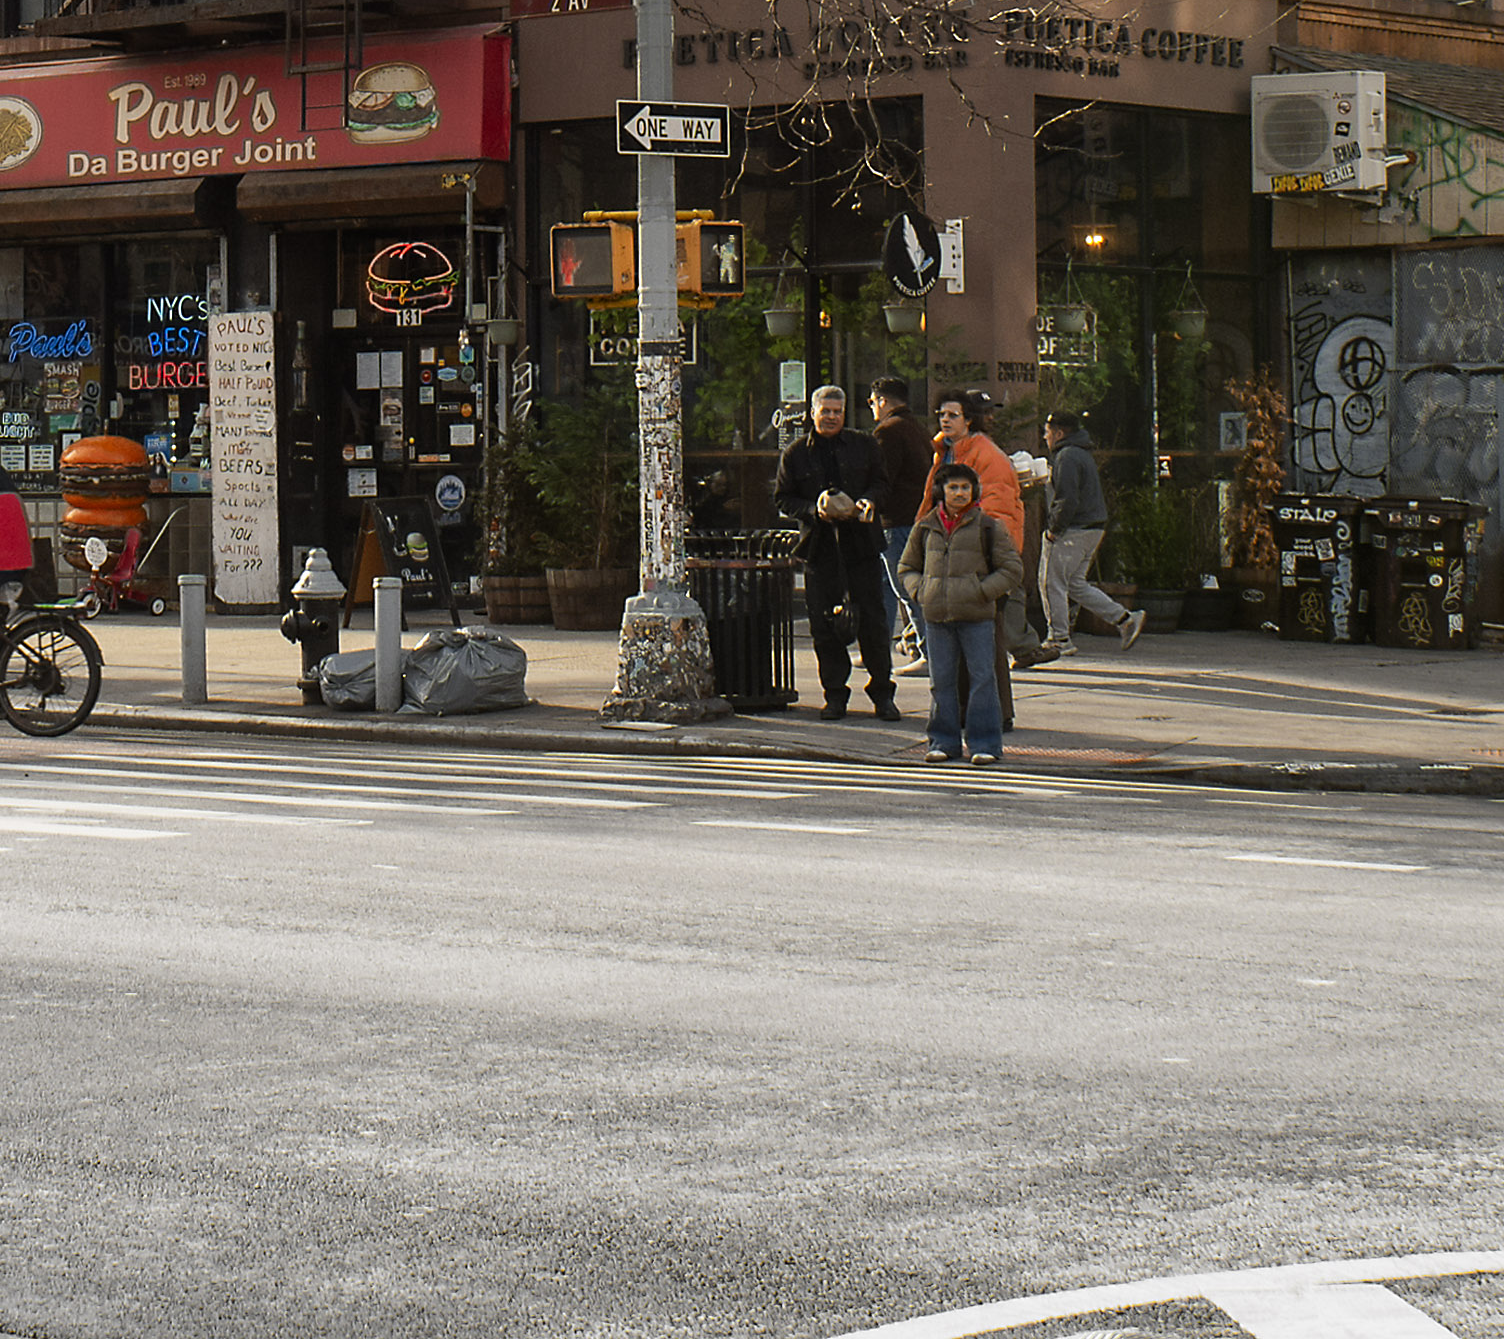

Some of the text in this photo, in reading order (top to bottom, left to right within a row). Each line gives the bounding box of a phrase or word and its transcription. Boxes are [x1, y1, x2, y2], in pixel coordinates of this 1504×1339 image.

[622, 27, 793, 70] PETICA
[1141, 27, 1245, 69] COFFEE
[109, 72, 278, 144] Paul's
[636, 118, 717, 141] ONE WAY
[67, 135, 317, 179] Da Burger Joint
[1323, 163, 1355, 187] GENIE
[147, 294, 208, 322] NYC's
[397, 309, 422, 326] 131
[216, 317, 266, 337] PAUL'S
[9, 319, 93, 363] Paul's
[147, 326, 207, 357] BEST
[214, 343, 249, 353] VOTED
[45, 364, 80, 378] SMASH
[129, 361, 207, 390] BURGE
[218, 377, 242, 390] HALF
[219, 458, 263, 475] BEERS
[219, 497, 266, 508] ALL DAY
[401, 567, 434, 582] Paul's
